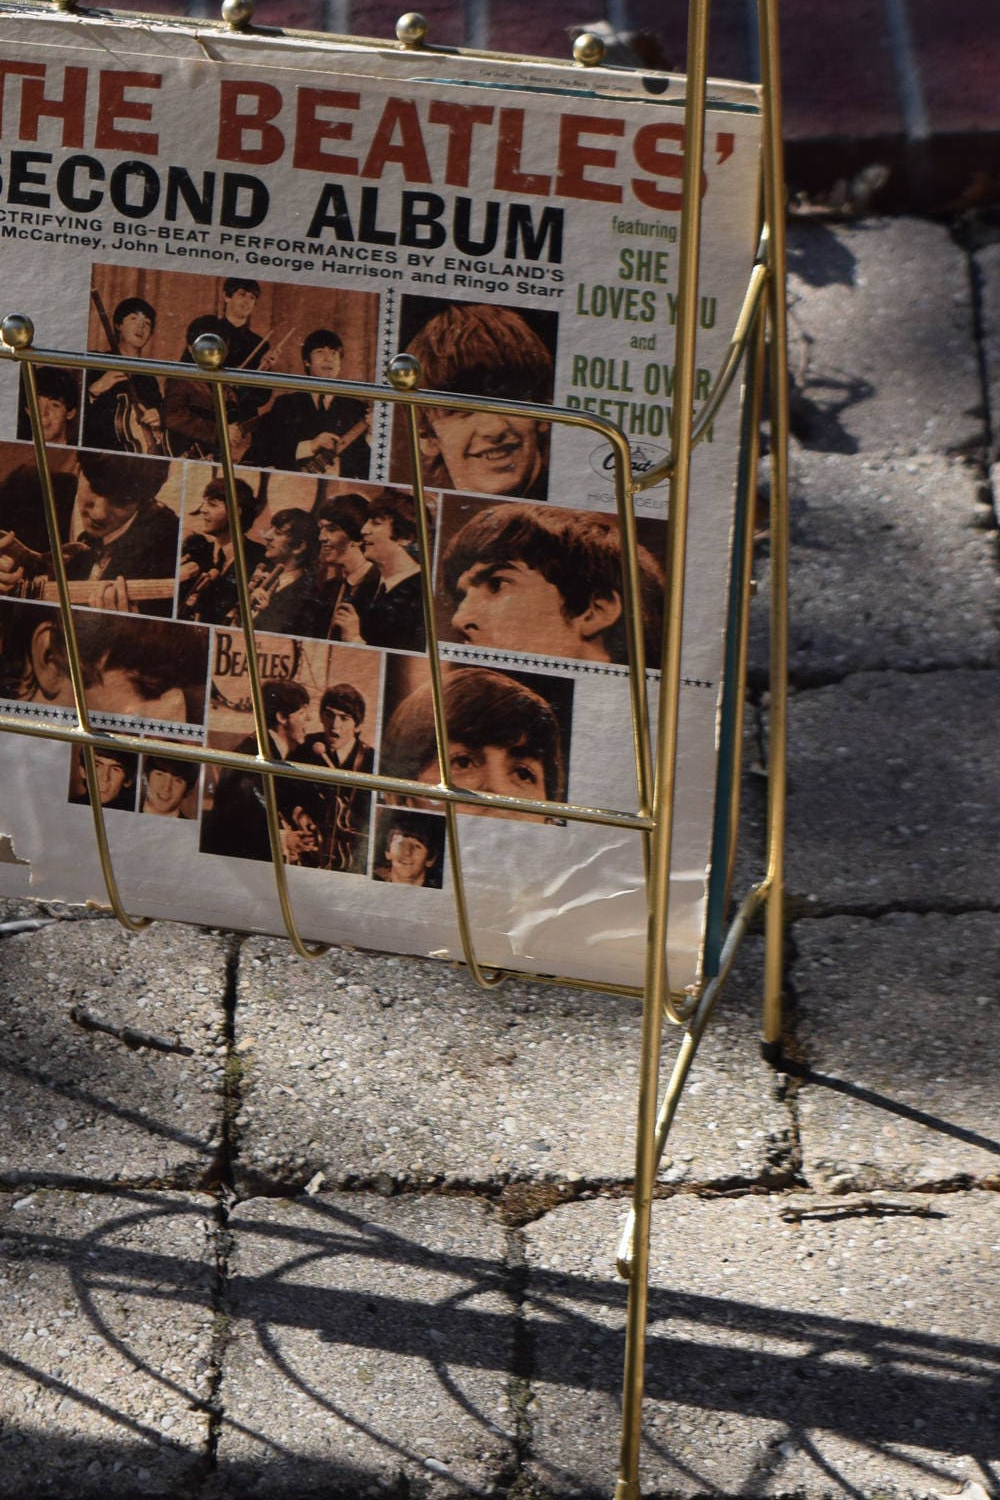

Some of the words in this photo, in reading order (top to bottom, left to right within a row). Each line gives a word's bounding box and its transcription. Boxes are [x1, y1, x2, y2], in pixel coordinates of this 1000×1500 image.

[216, 79, 735, 211] BEATLES'
[306, 183, 565, 265] ALBUM
[612, 216, 678, 243] featuring
[1, 226, 106, 250] McCartney,
[112, 238, 158, 254] John
[165, 243, 240, 264] Lennon,
[246, 252, 314, 272] George
[322, 260, 402, 280] Harrison
[410, 270, 446, 284] and
[453, 274, 510, 294] Ringo
[516, 282, 565, 298] Starr
[113, 222, 210, 244] BIG-BEAT
[220, 234, 398, 264] PERFORMANCES
[407, 253, 435, 268] BY
[444, 258, 564, 282] ENGLAND'S
[618, 248, 670, 284] SHE
[576, 282, 656, 322] LOVES
[666, 292, 717, 330] YU
[630, 333, 656, 352] and
[572, 354, 634, 393] ROLL
[644, 362, 711, 400] OVR
[566, 394, 714, 443] EETHOV
